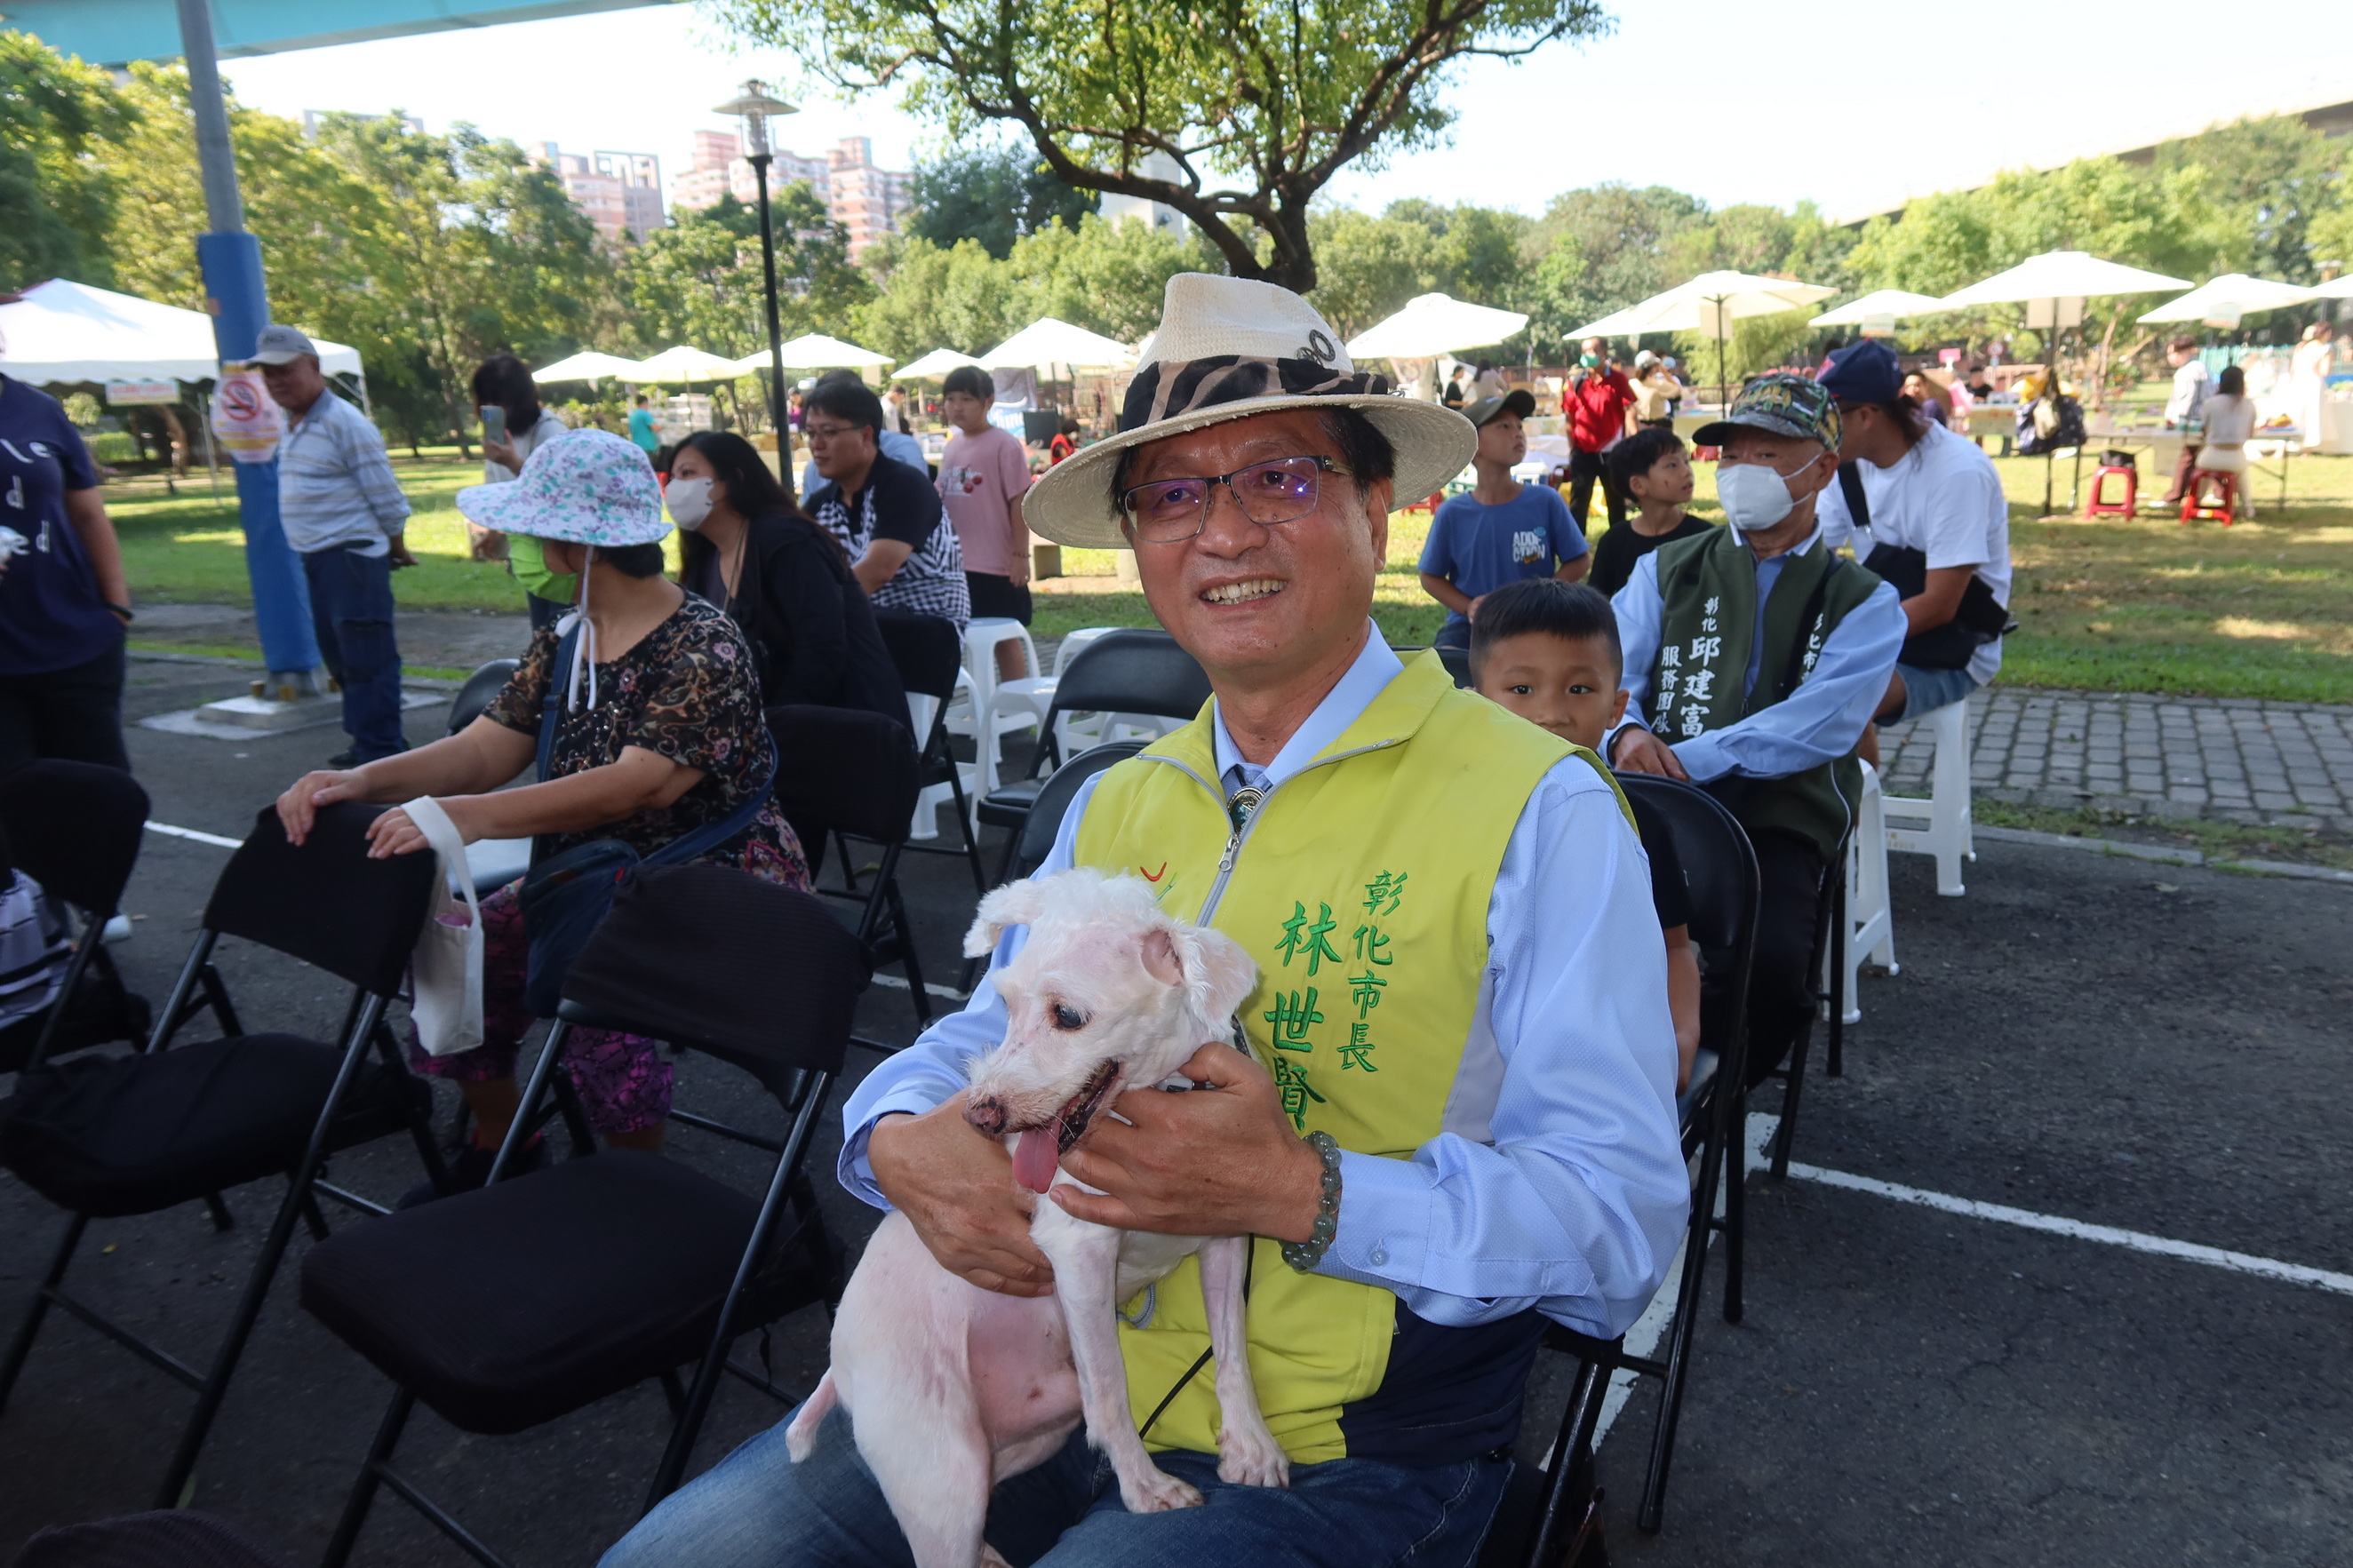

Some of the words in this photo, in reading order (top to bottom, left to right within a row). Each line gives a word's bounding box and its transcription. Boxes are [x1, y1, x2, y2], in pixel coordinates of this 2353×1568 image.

[1264, 901, 1343, 1131] 林世賢
[1337, 870, 1408, 1072] 彰化市長
